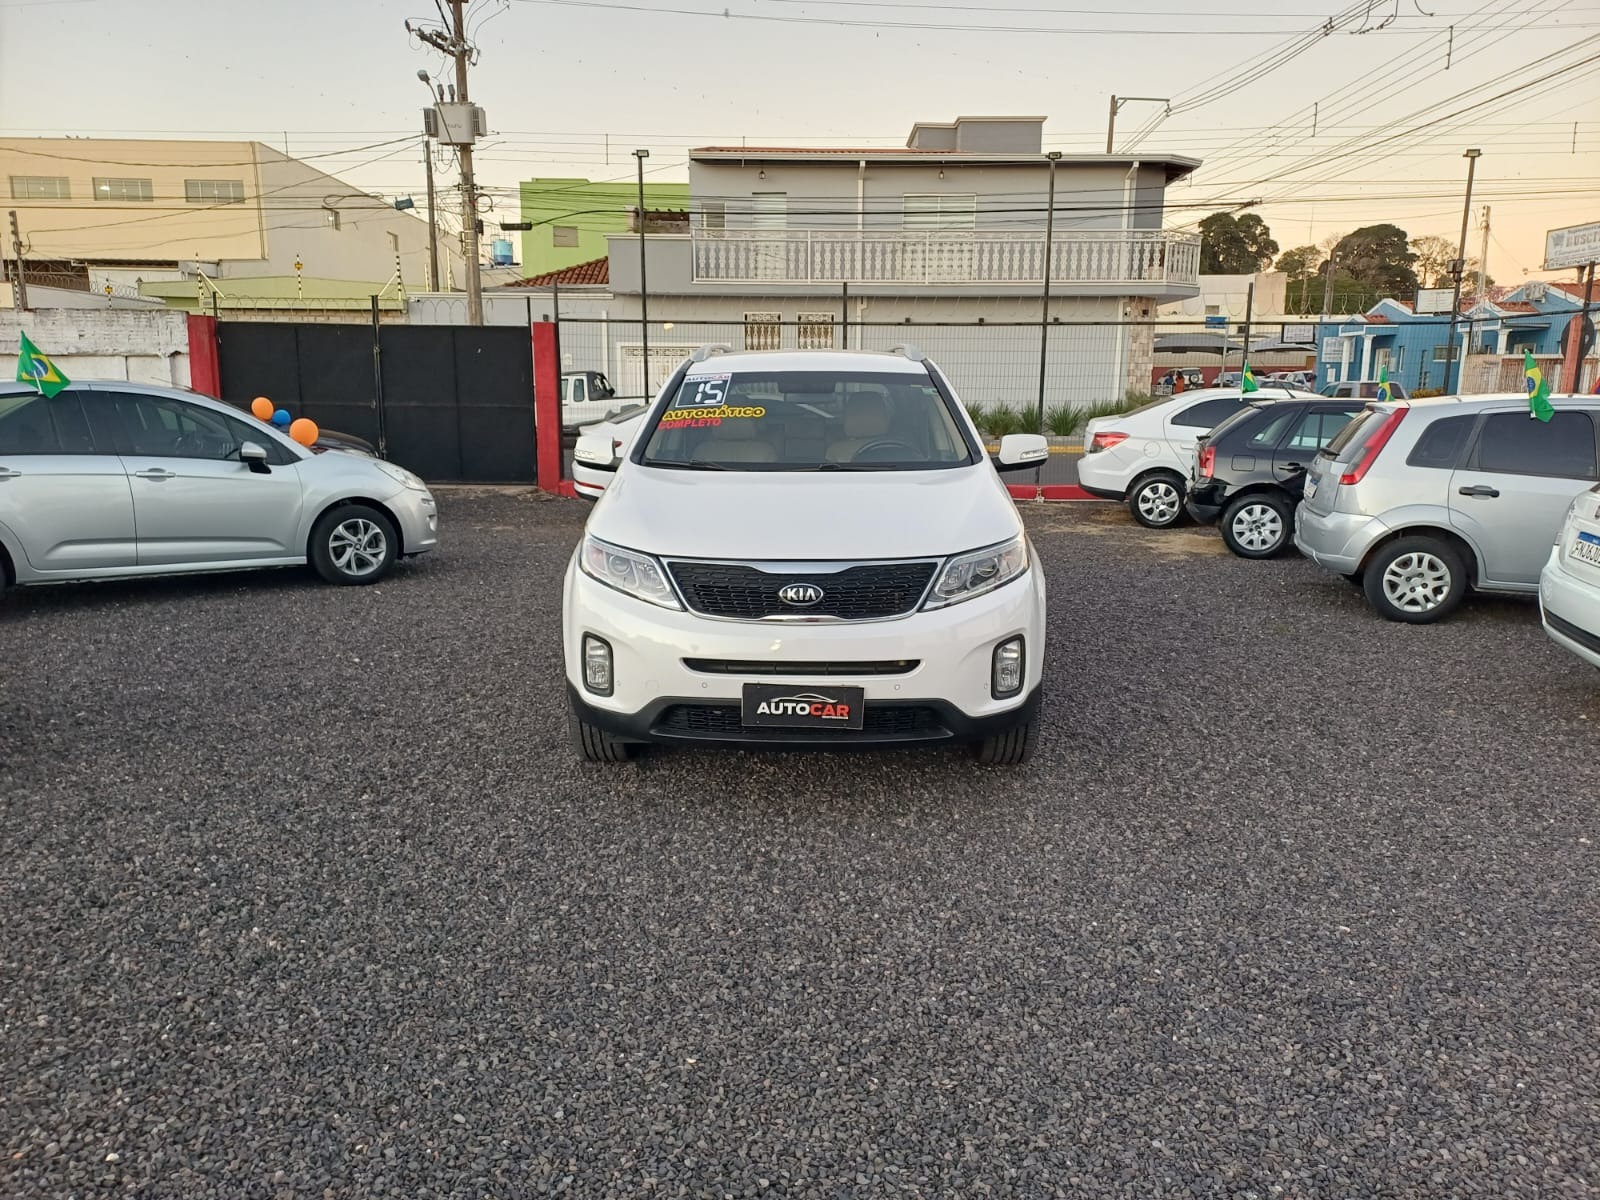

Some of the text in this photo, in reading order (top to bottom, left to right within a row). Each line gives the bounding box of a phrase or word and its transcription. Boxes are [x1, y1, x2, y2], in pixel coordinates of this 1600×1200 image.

[695, 381, 723, 404] 15
[663, 405, 765, 420] AUTOMÁTICO
[659, 418, 722, 430] COMPLETO
[787, 587, 816, 601] KIA
[756, 702, 850, 716] AUTOCAR
